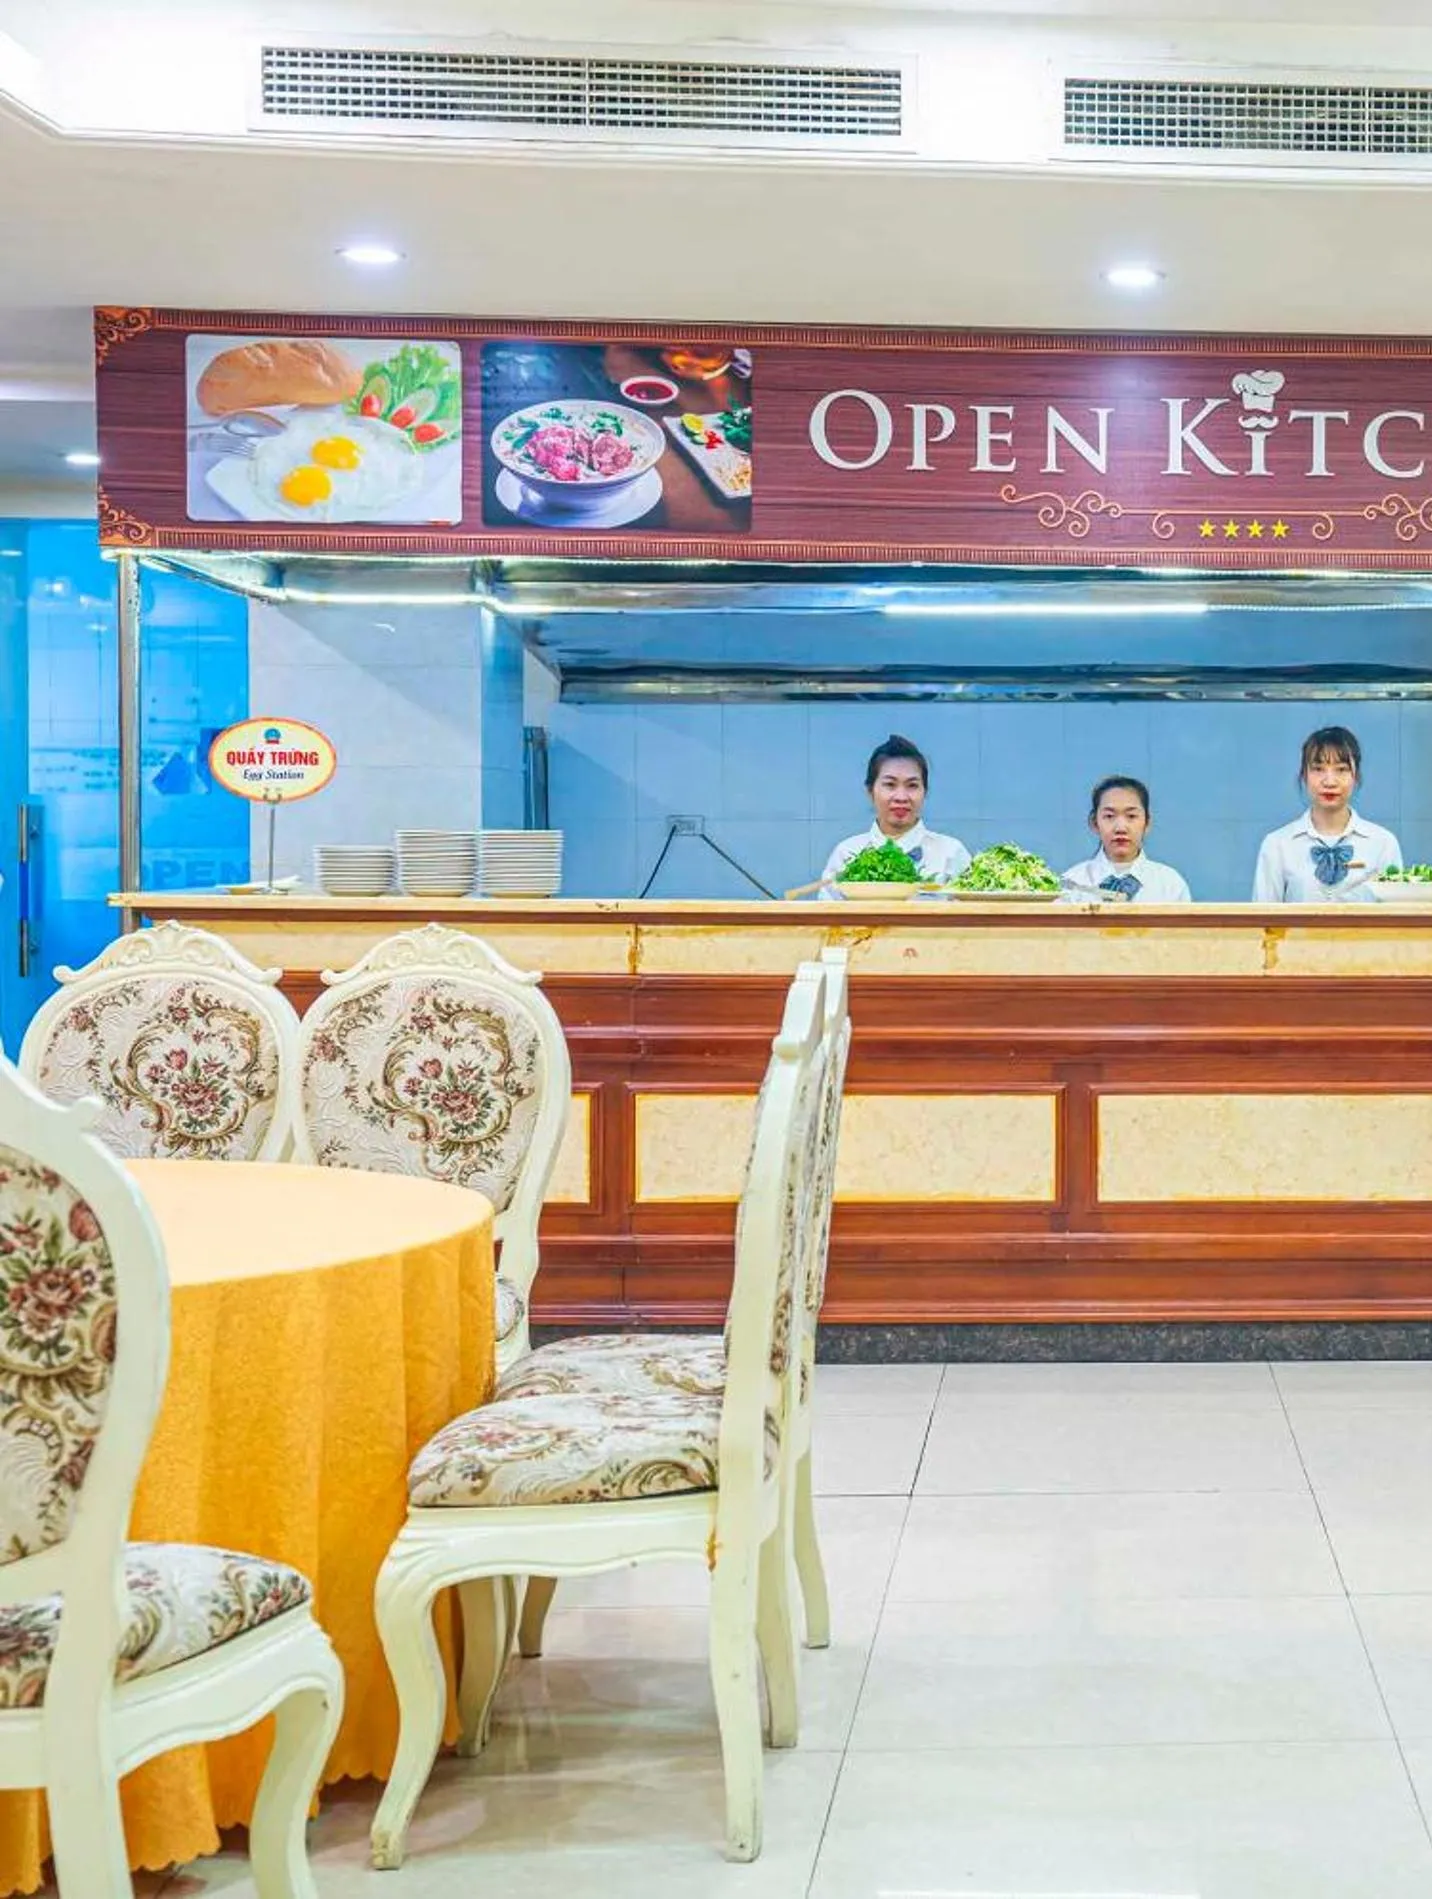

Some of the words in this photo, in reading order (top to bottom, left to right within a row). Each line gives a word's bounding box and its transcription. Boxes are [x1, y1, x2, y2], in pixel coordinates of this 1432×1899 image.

[808, 388, 1116, 473] OPEN
[243, 769, 263, 781] Egg
[265, 769, 305, 780] Station
